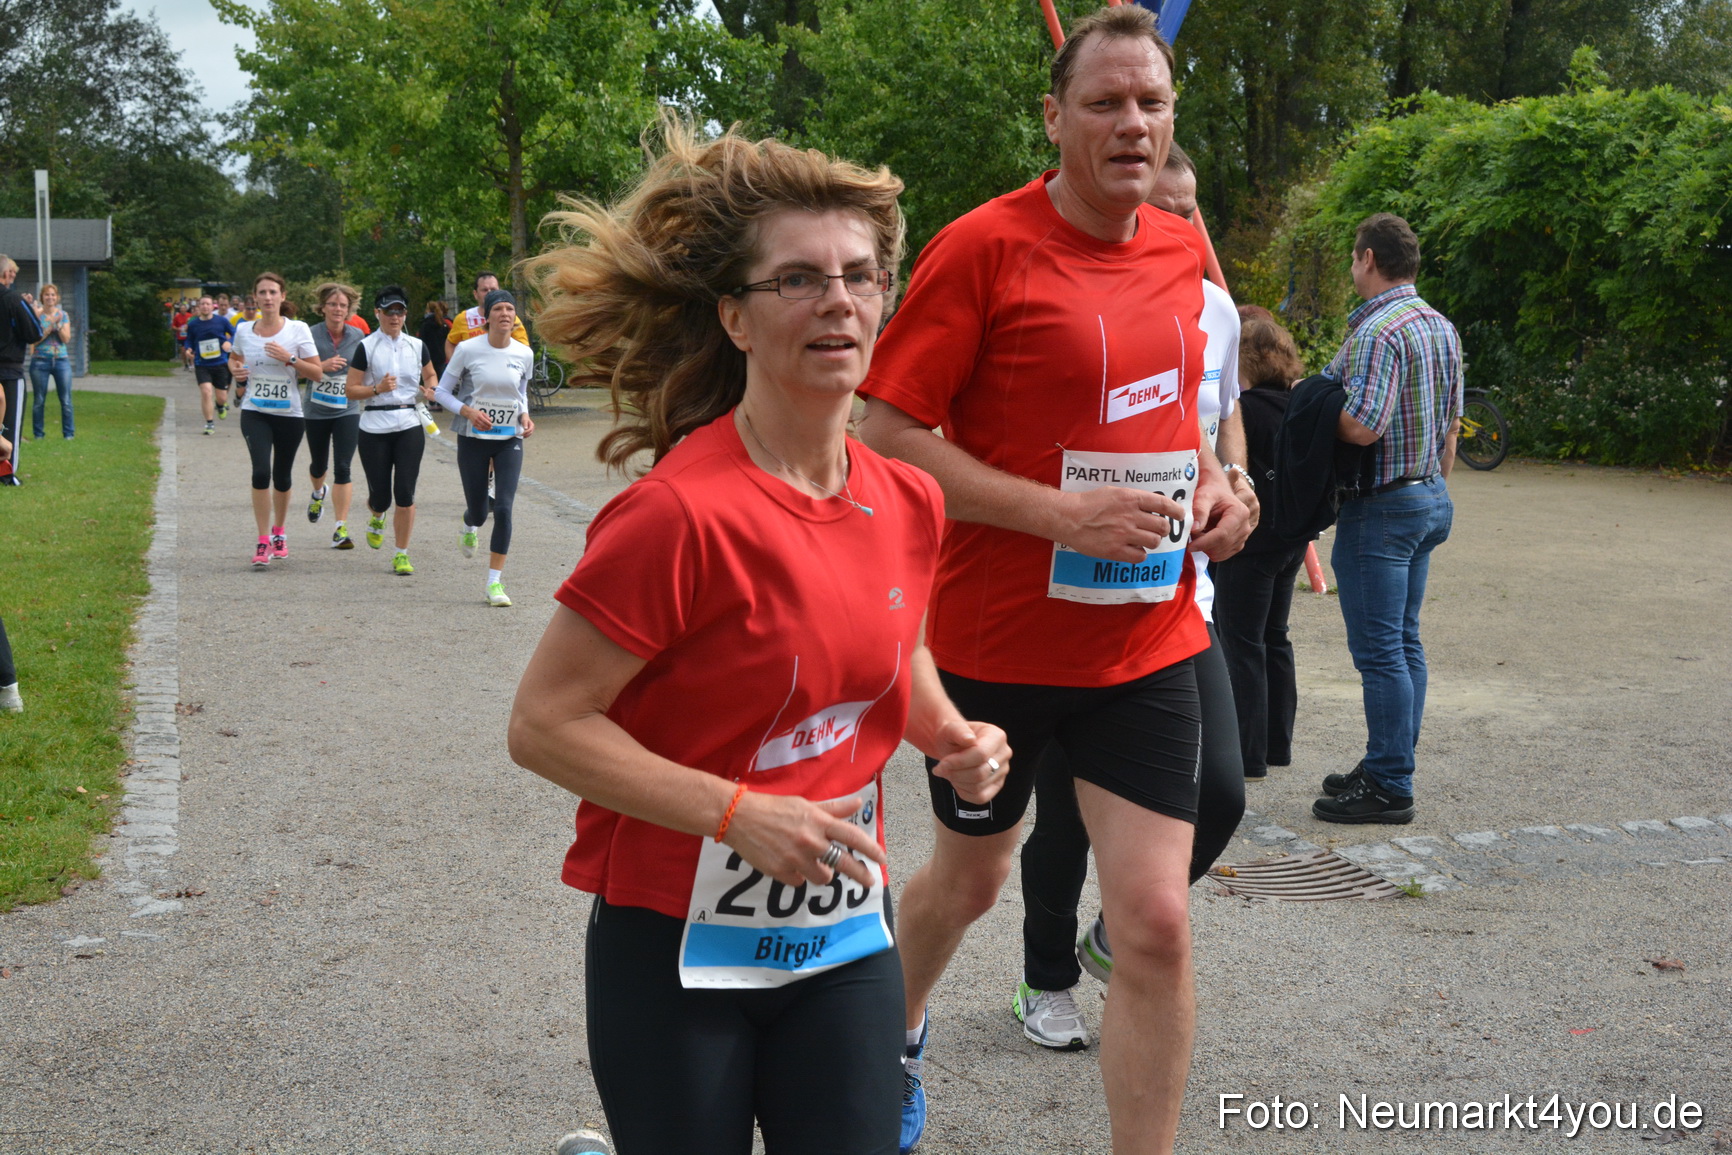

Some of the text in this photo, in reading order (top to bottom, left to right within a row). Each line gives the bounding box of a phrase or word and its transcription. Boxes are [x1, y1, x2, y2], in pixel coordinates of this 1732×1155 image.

[254, 383, 288, 399] 2548
[316, 381, 346, 395] 2258
[1128, 384, 1160, 407] DEHN
[1066, 466, 1182, 483] PARTL Neumarkt
[1093, 560, 1166, 583] Michael
[791, 716, 836, 749] DEHN
[698, 910, 706, 921] A
[754, 935, 826, 968] Birgit
